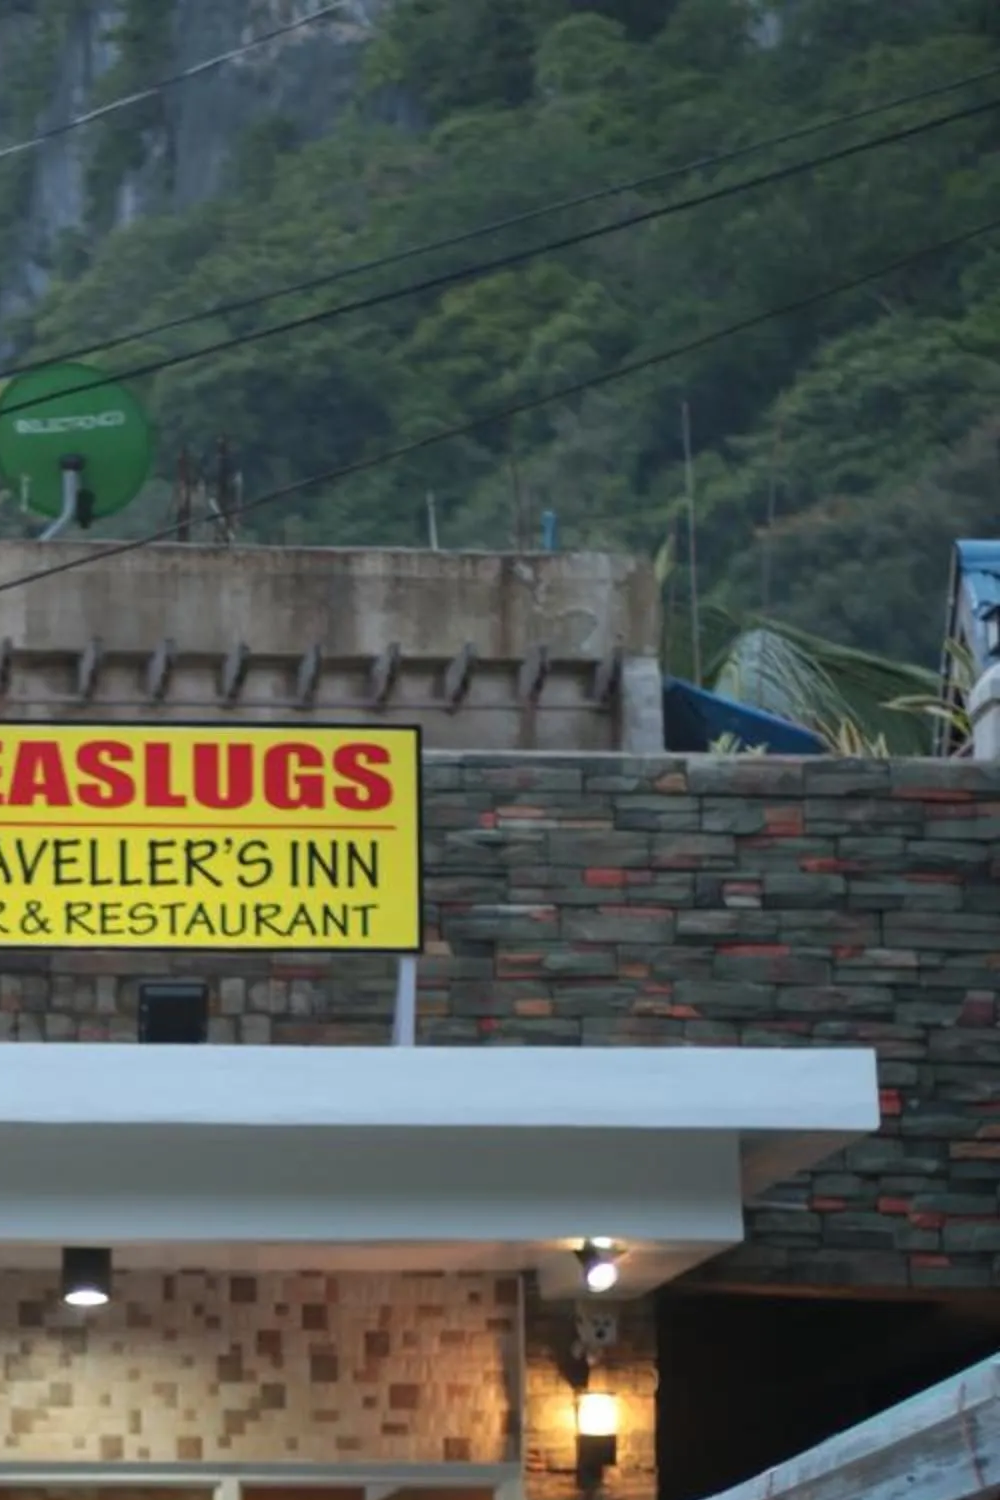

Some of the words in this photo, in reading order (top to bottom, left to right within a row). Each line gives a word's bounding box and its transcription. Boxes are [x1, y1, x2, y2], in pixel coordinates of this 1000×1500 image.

[290, 839, 379, 889] INN
[20, 901, 52, 935] &
[65, 900, 380, 938] RESTAURANT
